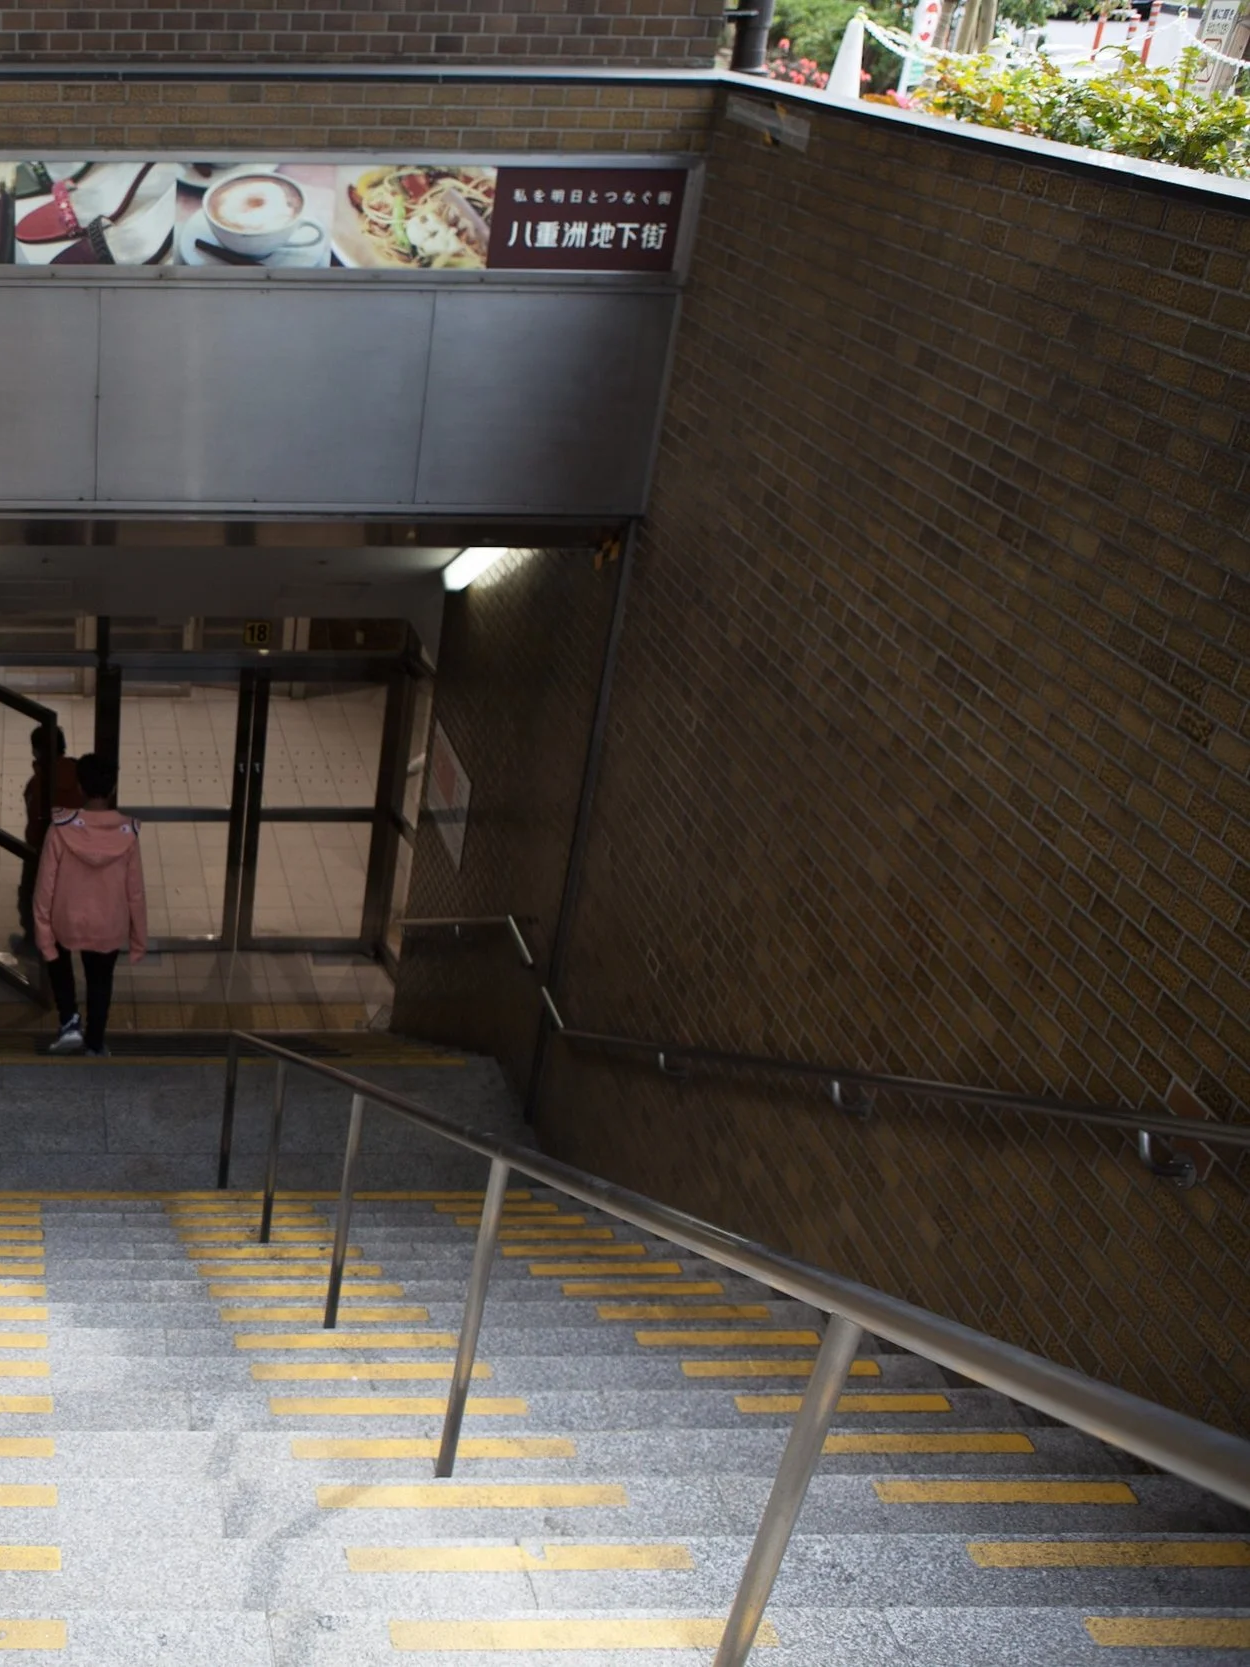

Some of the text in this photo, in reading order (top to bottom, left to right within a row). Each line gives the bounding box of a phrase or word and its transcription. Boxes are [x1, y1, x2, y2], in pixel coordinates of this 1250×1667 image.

[513, 188, 672, 205] 私を明日とつなぐ街
[507, 220, 667, 250] 八重洲地下街
[248, 623, 268, 642] 18
